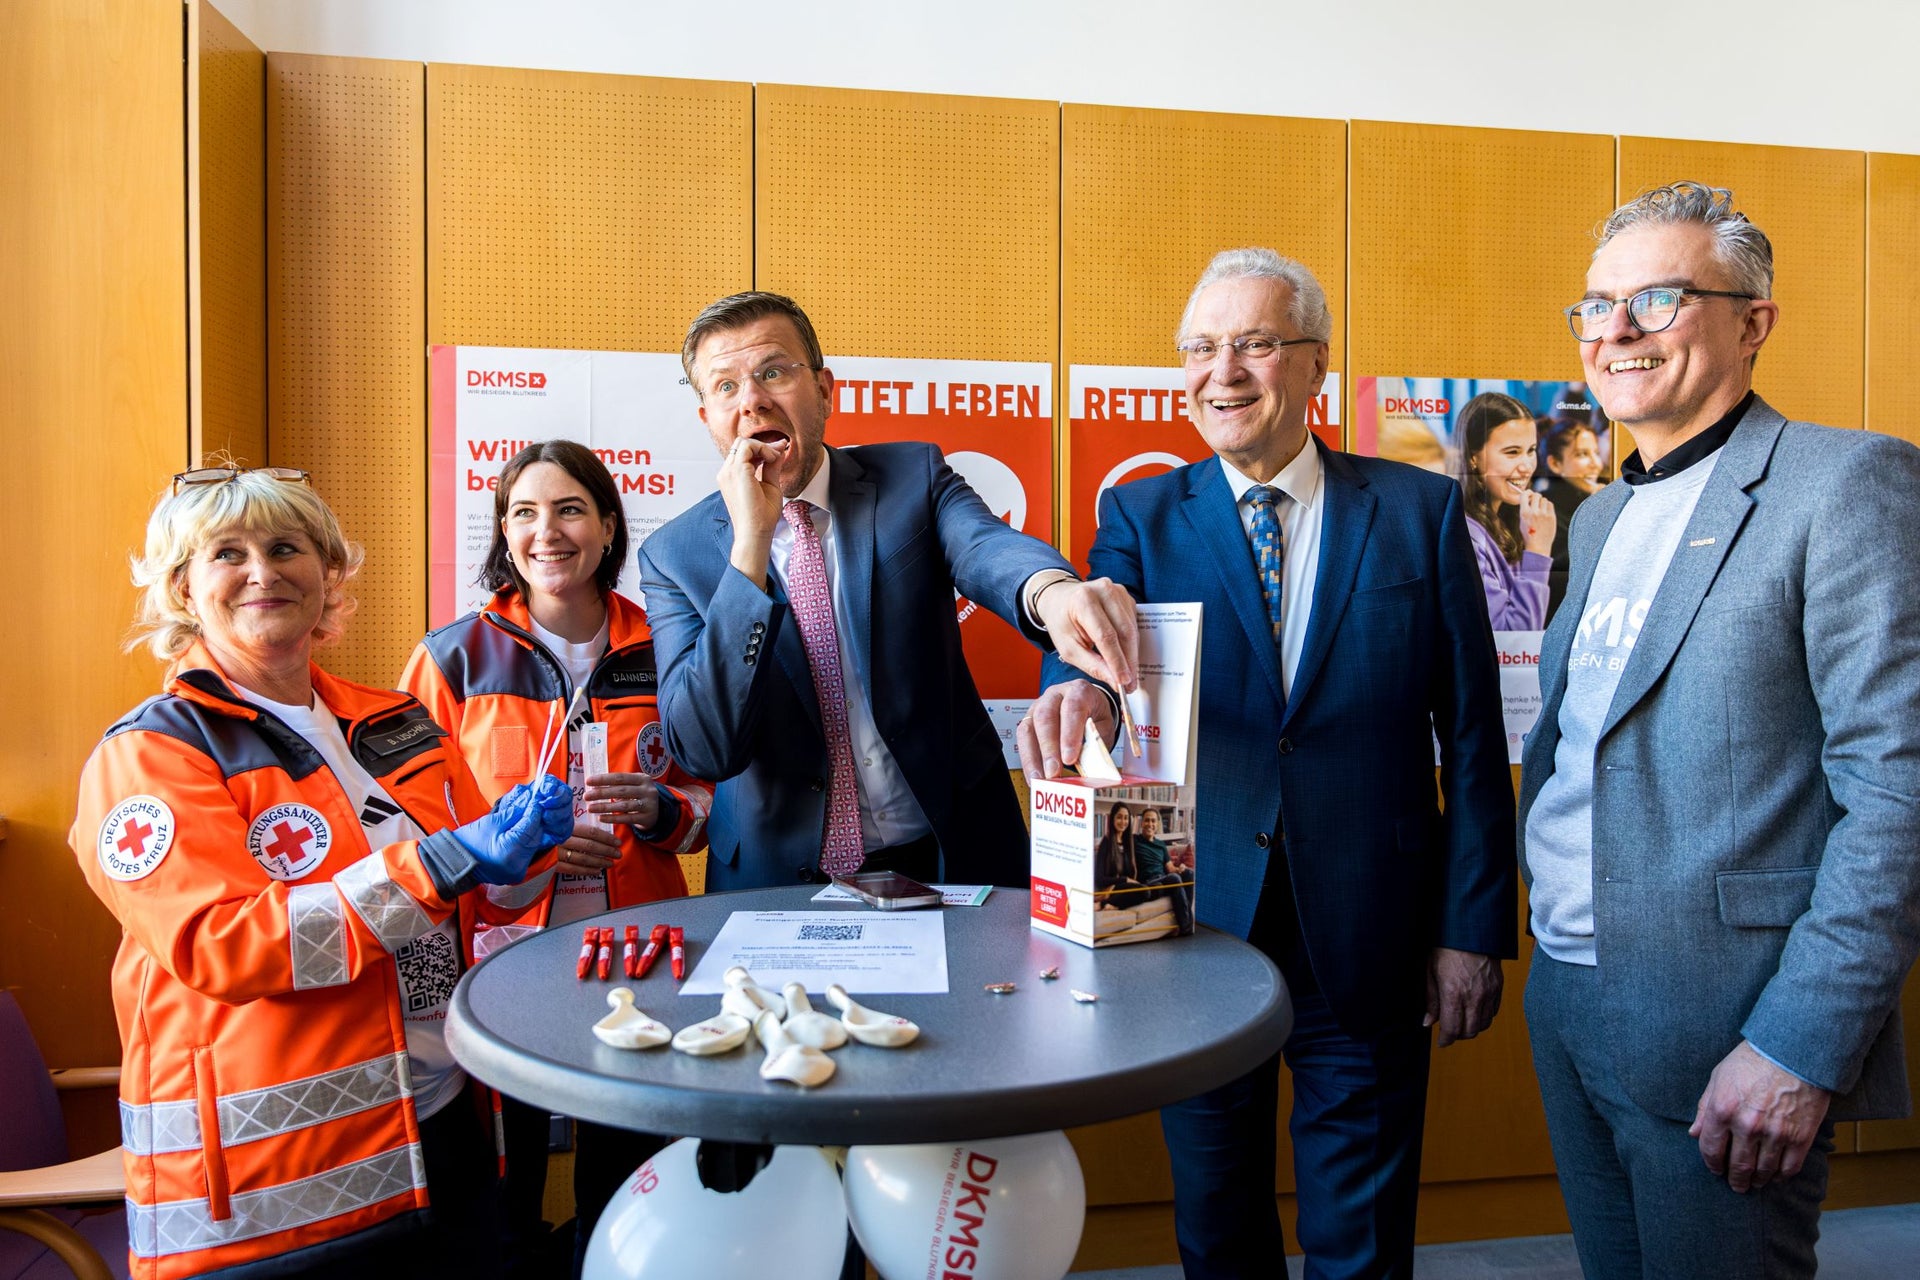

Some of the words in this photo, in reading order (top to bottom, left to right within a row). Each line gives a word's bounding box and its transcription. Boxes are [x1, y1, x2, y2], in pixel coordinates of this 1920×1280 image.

[467, 370, 527, 388] DKMS
[832, 379, 913, 415] TTET
[927, 381, 1040, 418] LEBEN
[1083, 387, 1188, 422] RETTE
[1385, 398, 1434, 413] DKMS
[1556, 401, 1592, 411] dkms.de
[467, 469, 499, 492] be
[1571, 596, 1652, 649] KMS
[612, 672, 657, 682] DANNEN
[1035, 790, 1073, 816] DKMS
[105, 803, 160, 844] DEUTSCHES
[250, 807, 328, 857] RETTUNGSSANITÄTER
[108, 853, 140, 874] ROTES
[144, 824, 167, 867] KREUZ
[950, 1147, 963, 1170] WIR
[935, 1172, 956, 1233] BESIEGEN
[945, 1151, 998, 1271] DKMS
